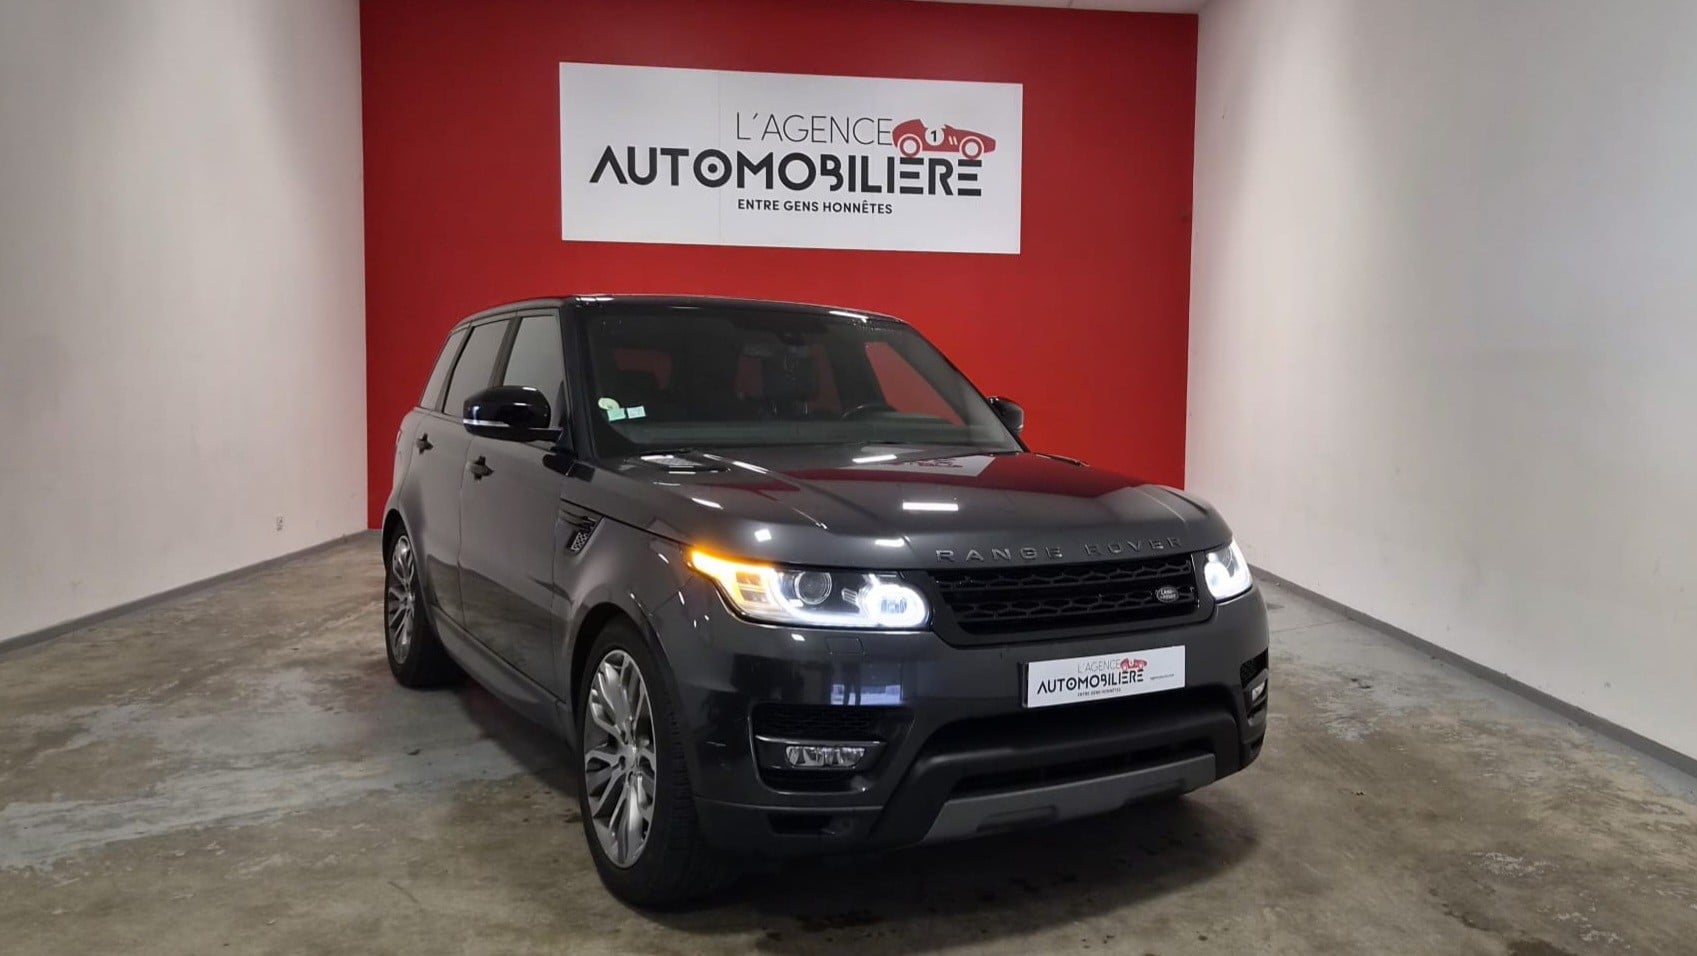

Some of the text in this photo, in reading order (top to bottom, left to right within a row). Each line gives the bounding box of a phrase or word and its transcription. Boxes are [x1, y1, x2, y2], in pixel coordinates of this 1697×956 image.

[931, 130, 937, 142] 1
[738, 199, 893, 214] ENTRE GENS HONNÊTES
[935, 537, 1183, 562] RANGE ROVER
